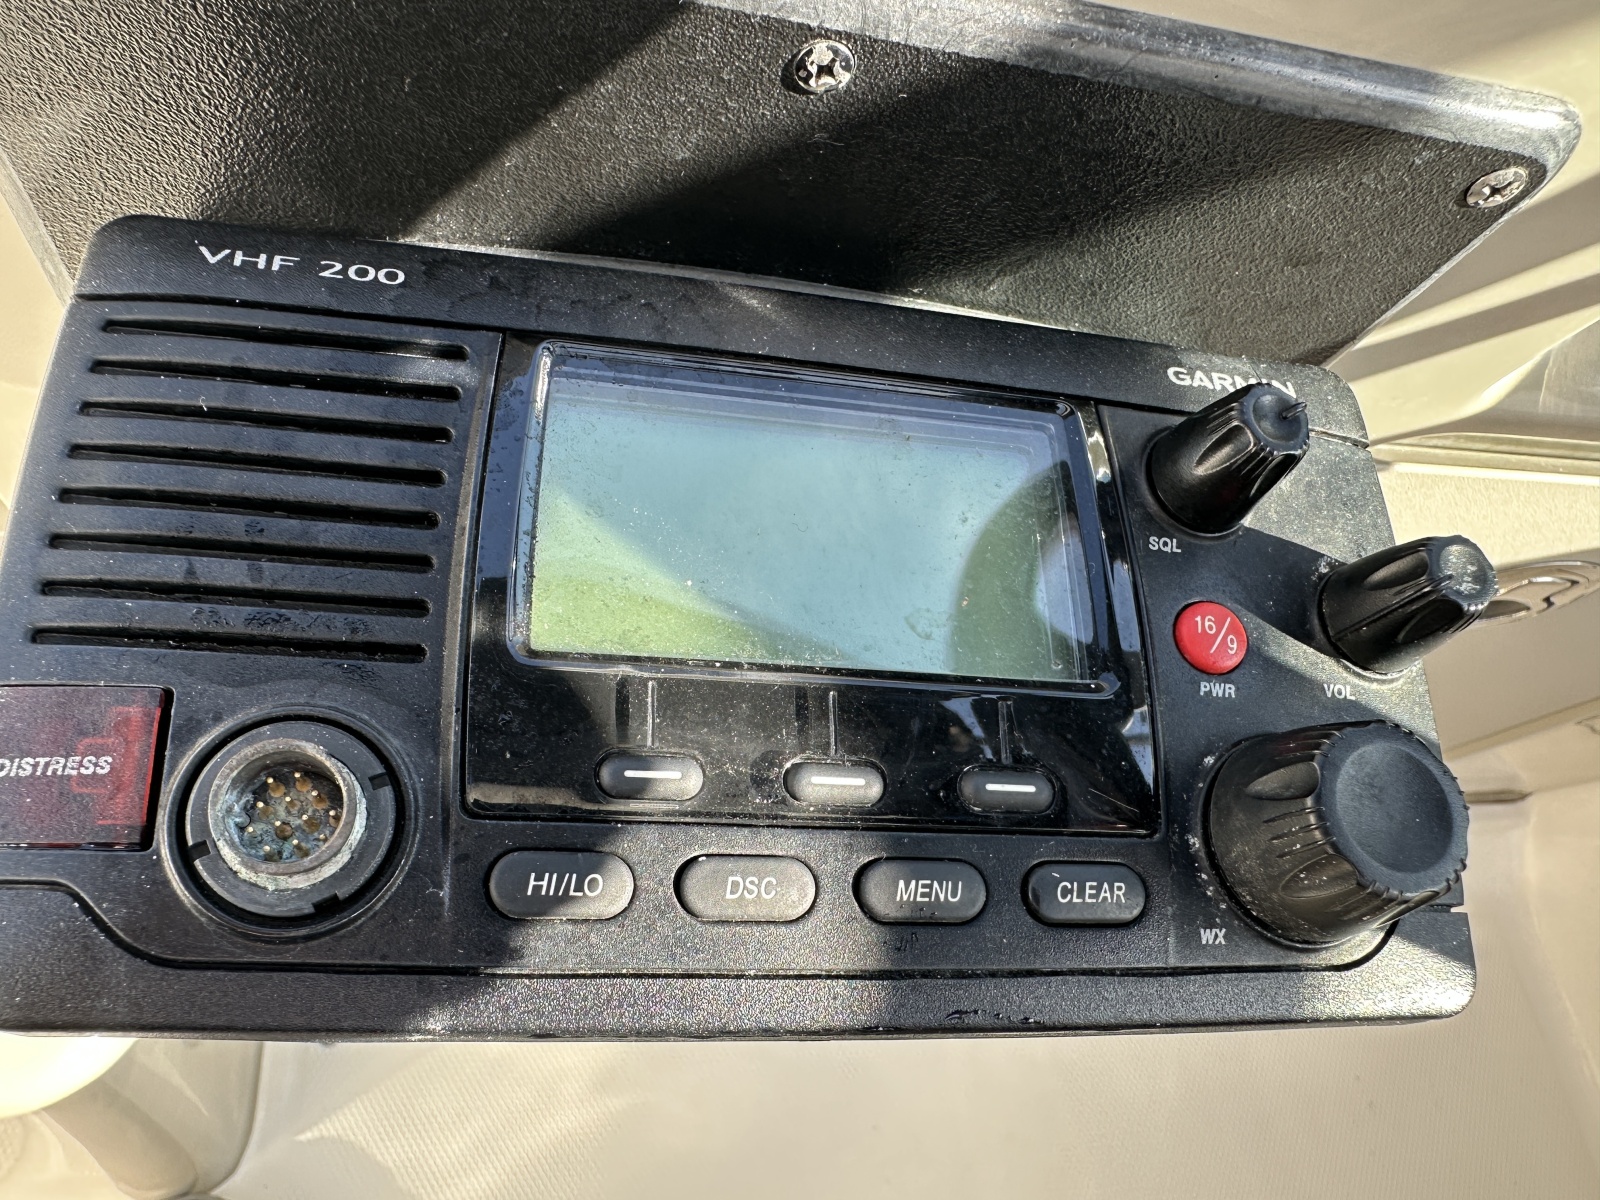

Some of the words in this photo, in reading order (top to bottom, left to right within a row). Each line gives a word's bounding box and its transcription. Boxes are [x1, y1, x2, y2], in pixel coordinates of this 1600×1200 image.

[199, 246, 300, 271] VHF
[318, 260, 405, 284] 200
[1166, 366, 1297, 398] GARMN
[1148, 536, 1182, 553] SQL
[1199, 681, 1236, 698] PWR
[1322, 683, 1356, 700] VOL
[526, 872, 604, 896] HI/LO
[725, 876, 777, 899] DSC
[895, 880, 962, 902] MENU
[1056, 882, 1126, 903] CLEAR
[1199, 928, 1226, 945] WX
